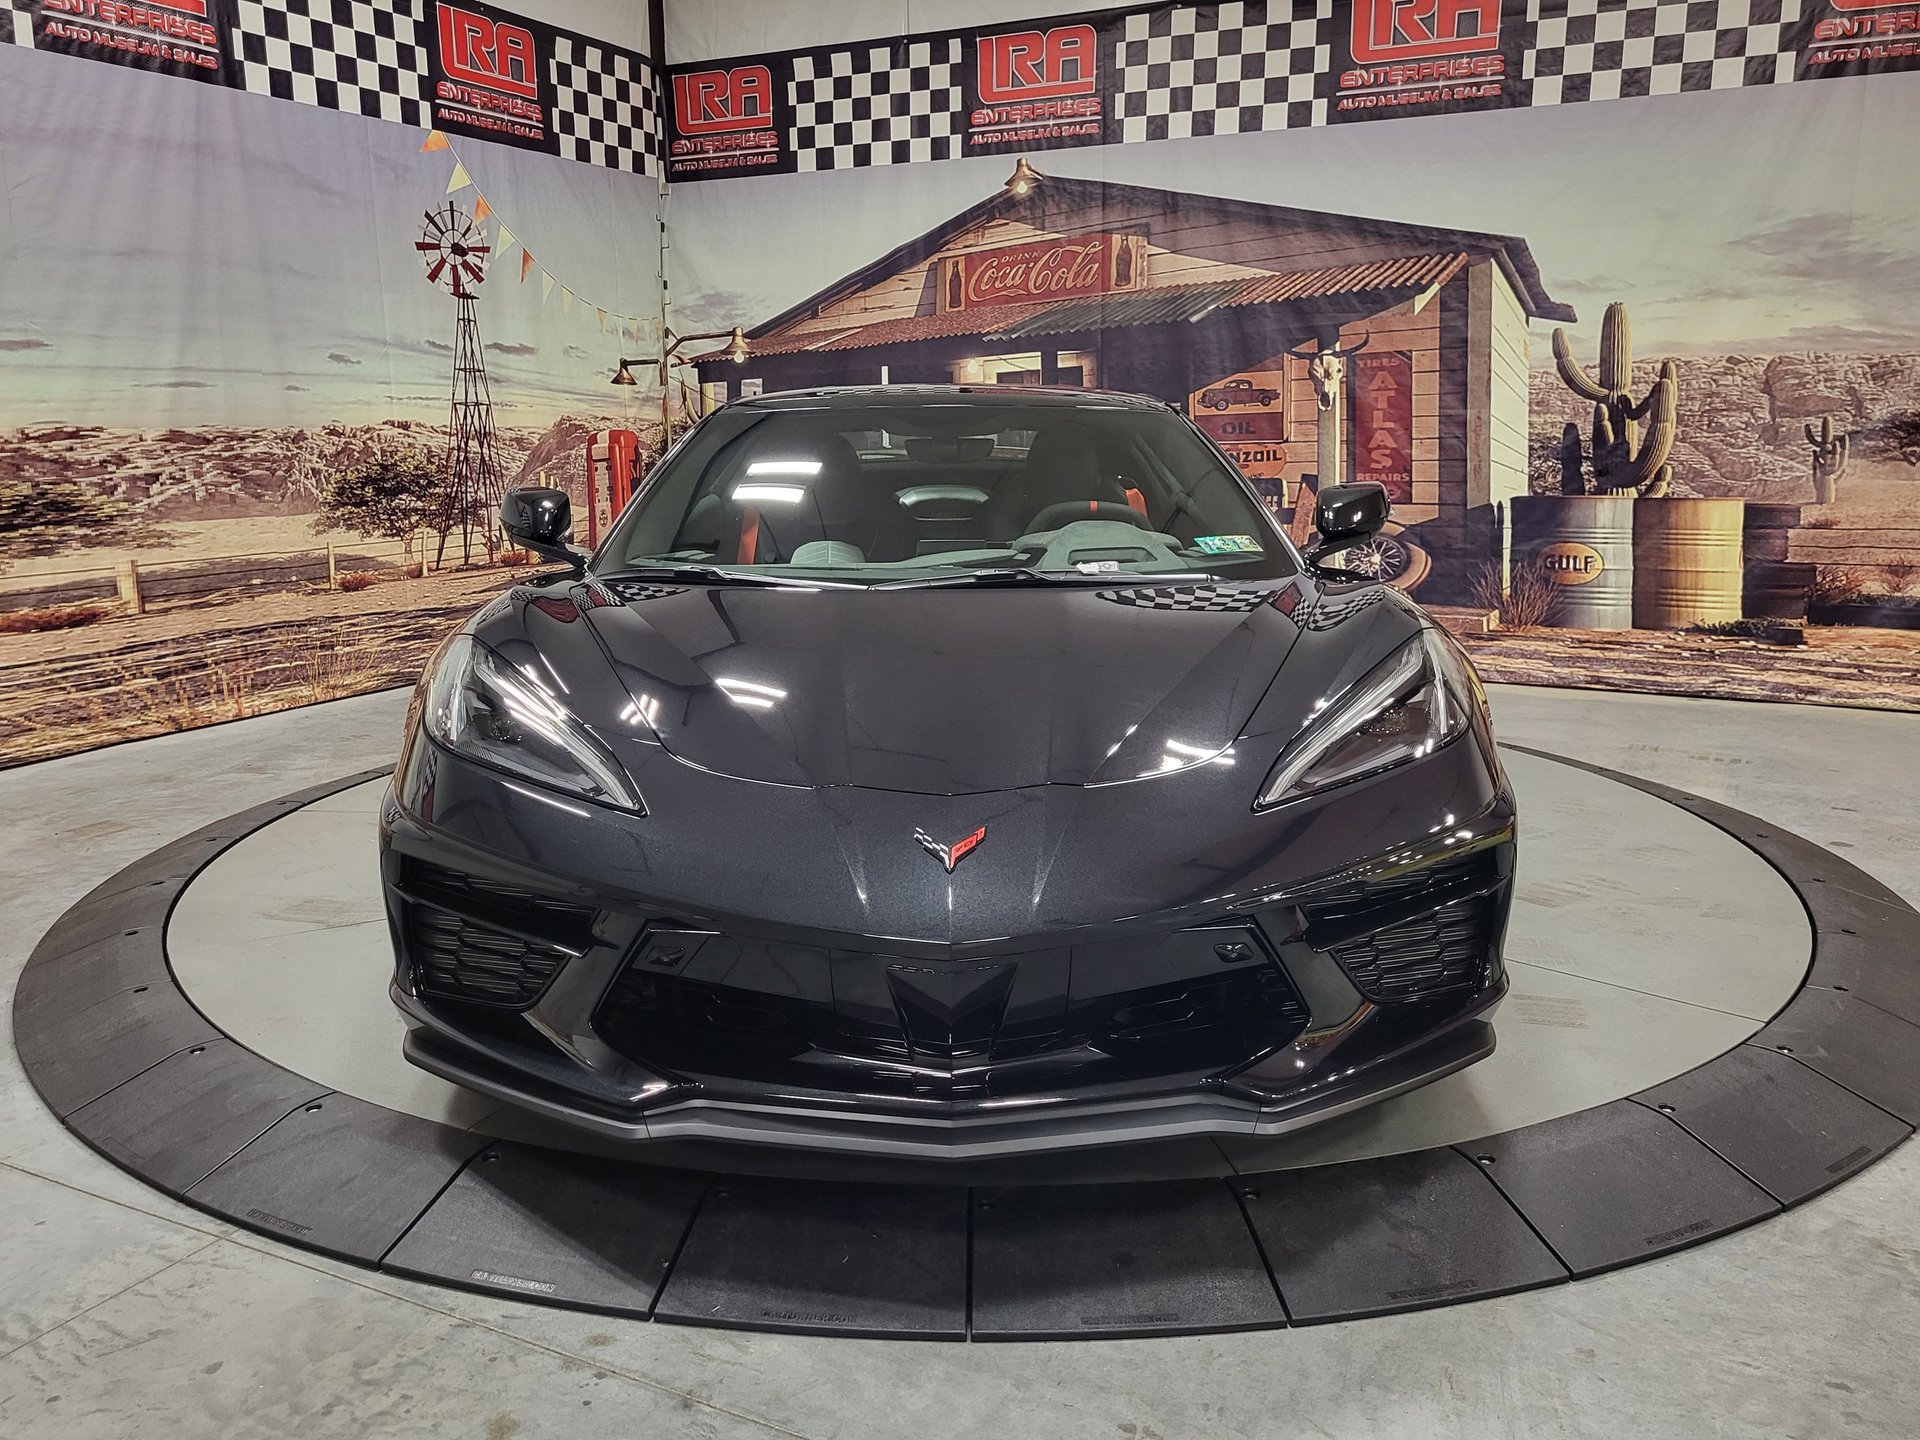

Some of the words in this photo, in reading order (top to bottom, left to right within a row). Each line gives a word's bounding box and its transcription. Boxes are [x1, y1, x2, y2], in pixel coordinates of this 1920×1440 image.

[1813, 11, 1920, 40] ENTER
[45, 21, 91, 42] AUTO
[93, 31, 160, 57] MUSEUM
[162, 46, 171, 60] &
[173, 48, 218, 70] SALES
[1808, 48, 1861, 65] AUTO
[1340, 55, 1505, 89] ENTERPRISES
[436, 80, 543, 121] ENTERPRISES
[1337, 97, 1377, 111] AUTO
[1377, 91, 1440, 107] MUSEUM
[1441, 88, 1452, 101] &
[1453, 84, 1502, 99] SALES
[970, 97, 1101, 126] ENTERPRISES
[438, 107, 465, 124] AUTO
[465, 113, 507, 132] MUSEUM
[507, 122, 515, 135] &
[514, 124, 544, 141] SALES
[970, 133, 1002, 145] AUTO
[1001, 128, 1051, 143] MUSEUM
[1051, 126, 1061, 138] &
[1061, 123, 1100, 136] SALES
[671, 130, 779, 155] ENTERPRISES
[671, 160, 698, 172] AUTO
[698, 155, 739, 170] MUSEUM
[746, 153, 778, 165] SALES
[1001, 250, 1041, 263] DRINK
[1357, 358, 1400, 368] TIRES
[1221, 421, 1257, 436] OIL
[1367, 370, 1399, 470] ATLAS
[1227, 449, 1282, 463] NZOIL
[1356, 472, 1410, 481] REPAIRS
[1545, 554, 1594, 574] GULF
